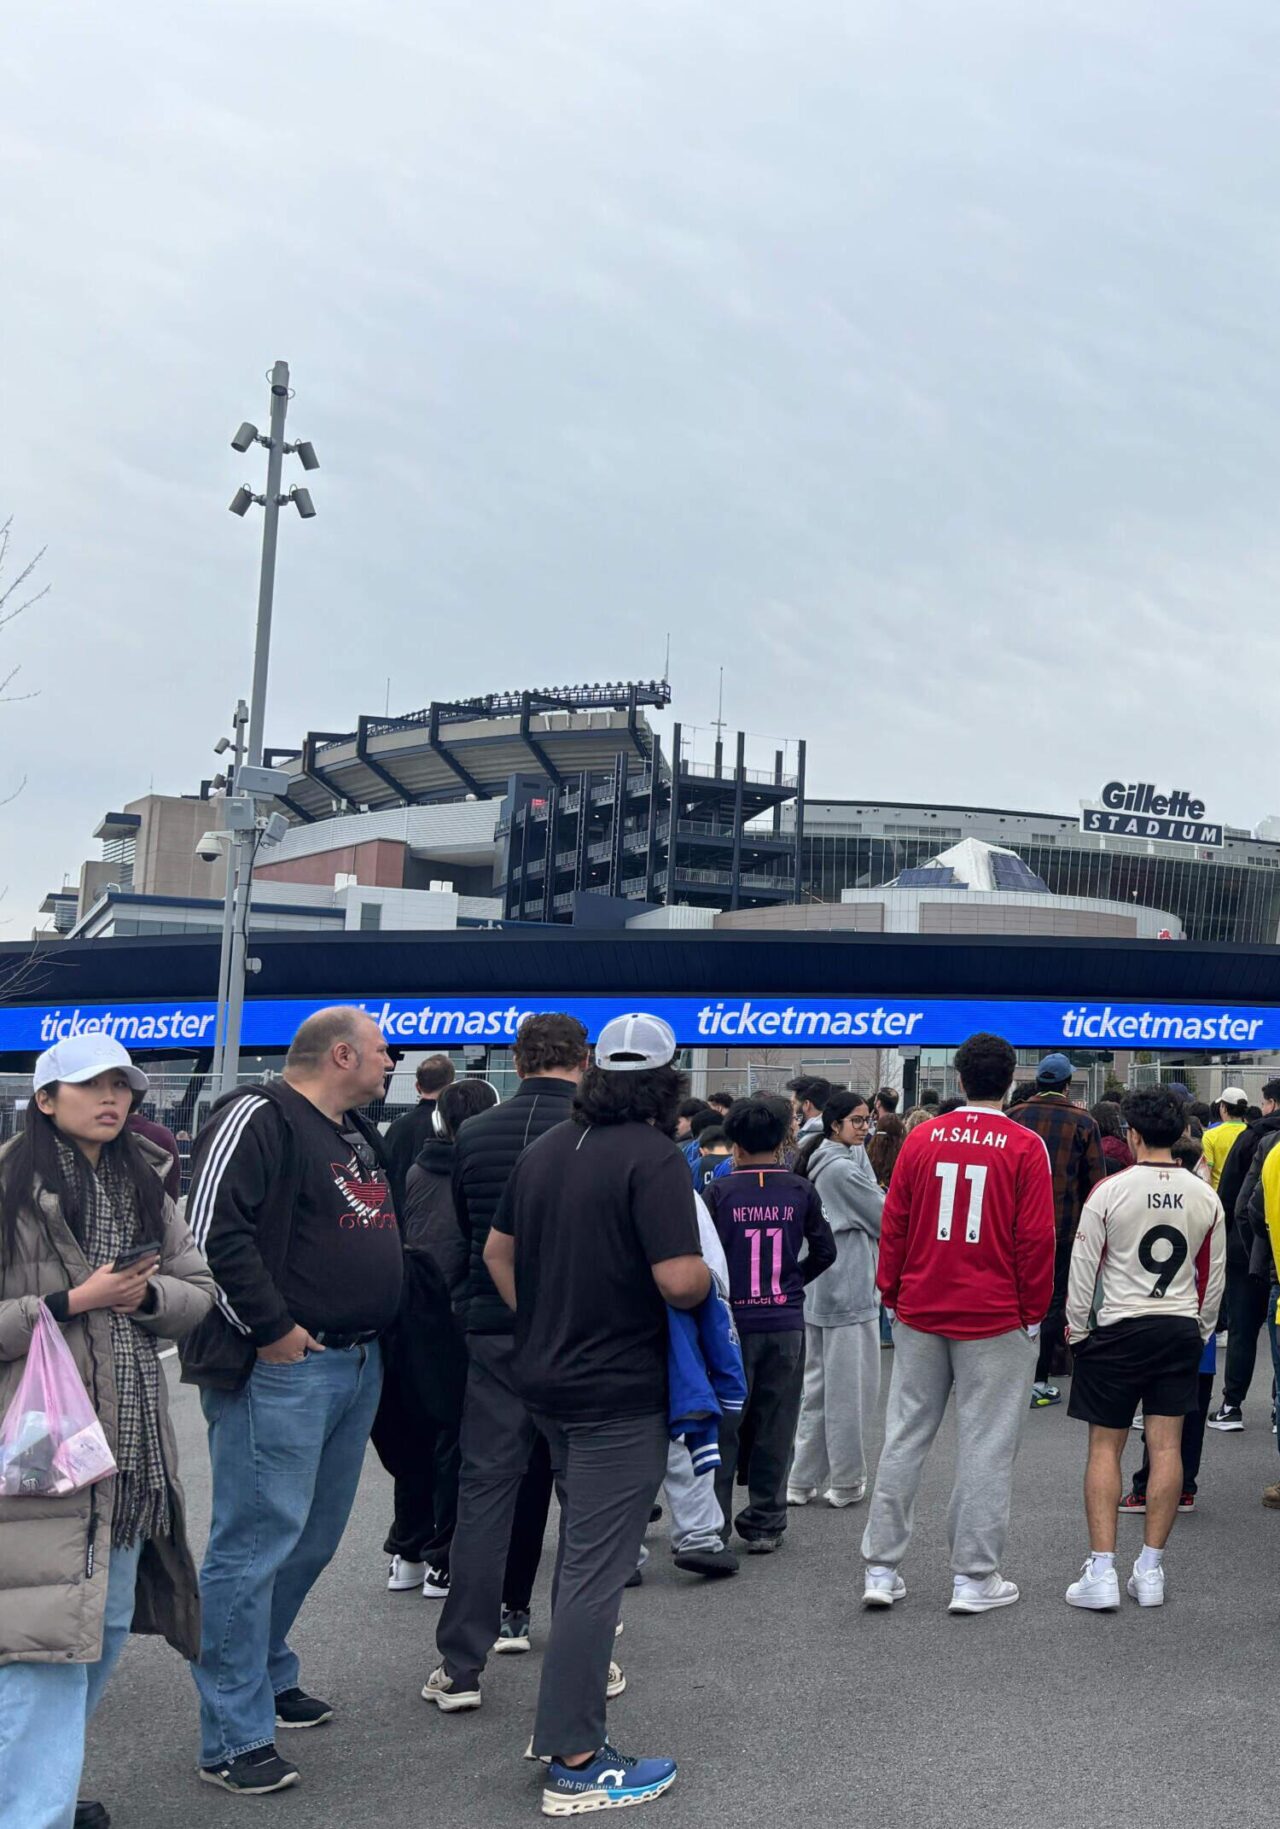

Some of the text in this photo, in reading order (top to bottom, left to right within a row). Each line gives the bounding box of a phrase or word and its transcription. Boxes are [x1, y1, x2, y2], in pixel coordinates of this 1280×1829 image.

[1102, 781, 1206, 820] Gillette
[1089, 813, 1217, 843] STADIUM
[40, 1009, 216, 1041] ticketmaster
[696, 1002, 923, 1036] ticketmaster
[1061, 1006, 1263, 1041] ticketmaster
[930, 1127, 1008, 1149] M.SALAH
[733, 1206, 794, 1222] NEYMAR JR
[935, 1162, 988, 1243] 11
[1147, 1193, 1184, 1209] ISAK
[745, 1228, 783, 1297] 11
[1138, 1224, 1188, 1298] 9
